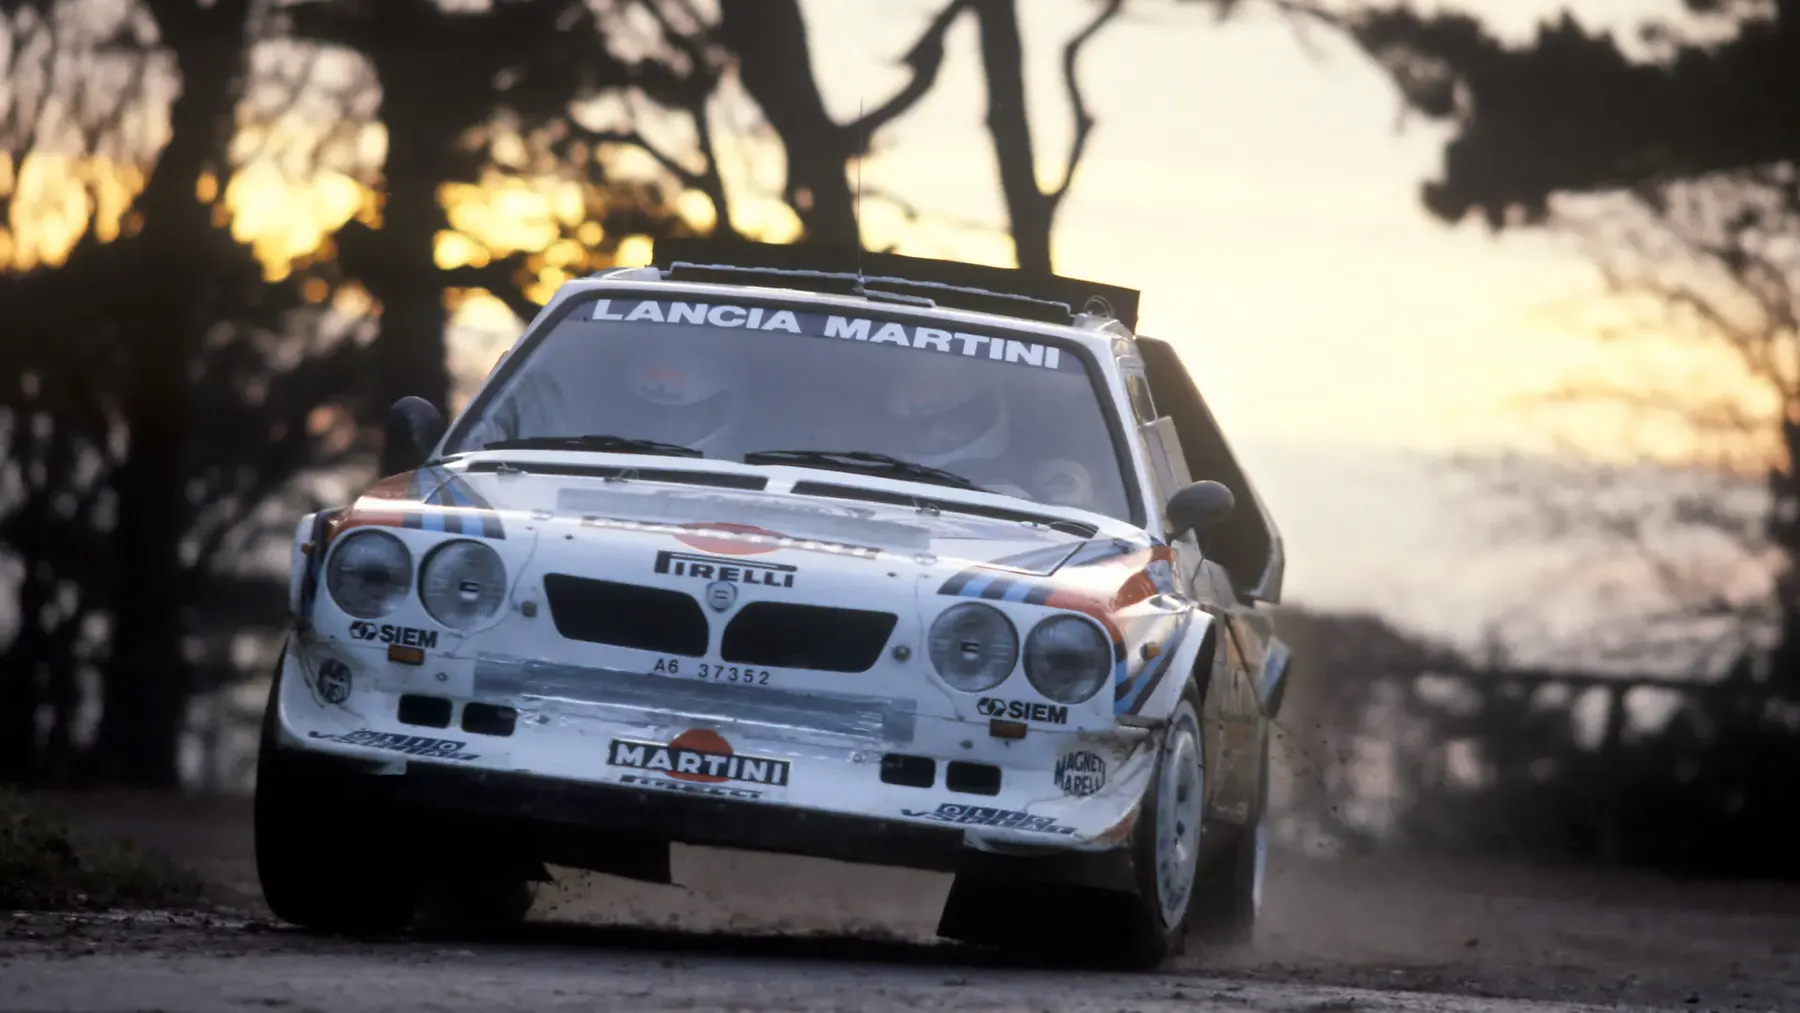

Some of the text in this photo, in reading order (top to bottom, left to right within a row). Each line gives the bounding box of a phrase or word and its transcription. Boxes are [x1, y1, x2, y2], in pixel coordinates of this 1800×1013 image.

[592, 299, 1060, 369] LANCIA MARTINI
[654, 550, 797, 588] PIRELLI
[379, 624, 438, 648] SIEM
[654, 658, 770, 685] A6 37352
[1007, 701, 1068, 725] SIEM
[615, 743, 783, 785] MARTINI
